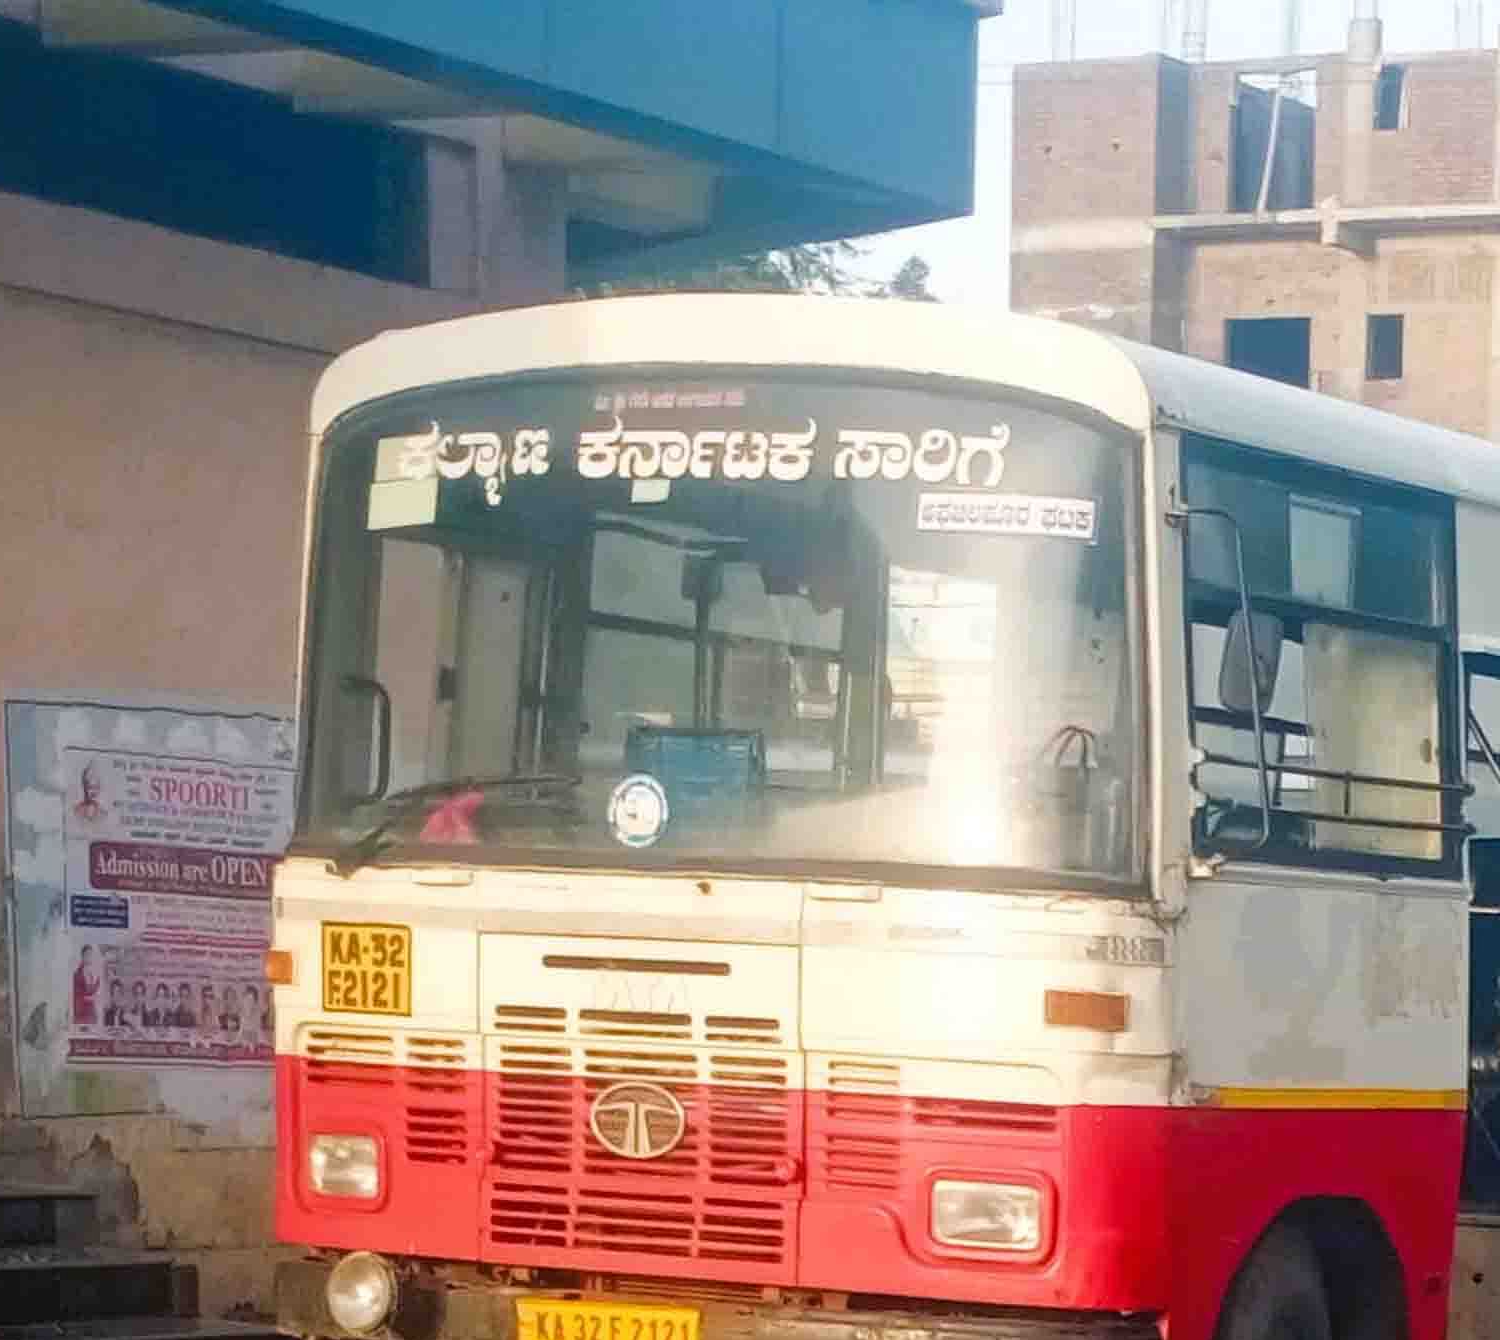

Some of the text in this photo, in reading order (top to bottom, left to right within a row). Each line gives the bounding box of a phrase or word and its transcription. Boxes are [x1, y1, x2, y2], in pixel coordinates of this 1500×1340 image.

[398, 415, 1012, 507] ಕಲ್ಯಾಣ ಕರ್ನಾಟಕ ಸಾರಿಗೆ
[150, 777, 250, 811] SPOORTI
[97, 849, 269, 886] Admission are OPEN
